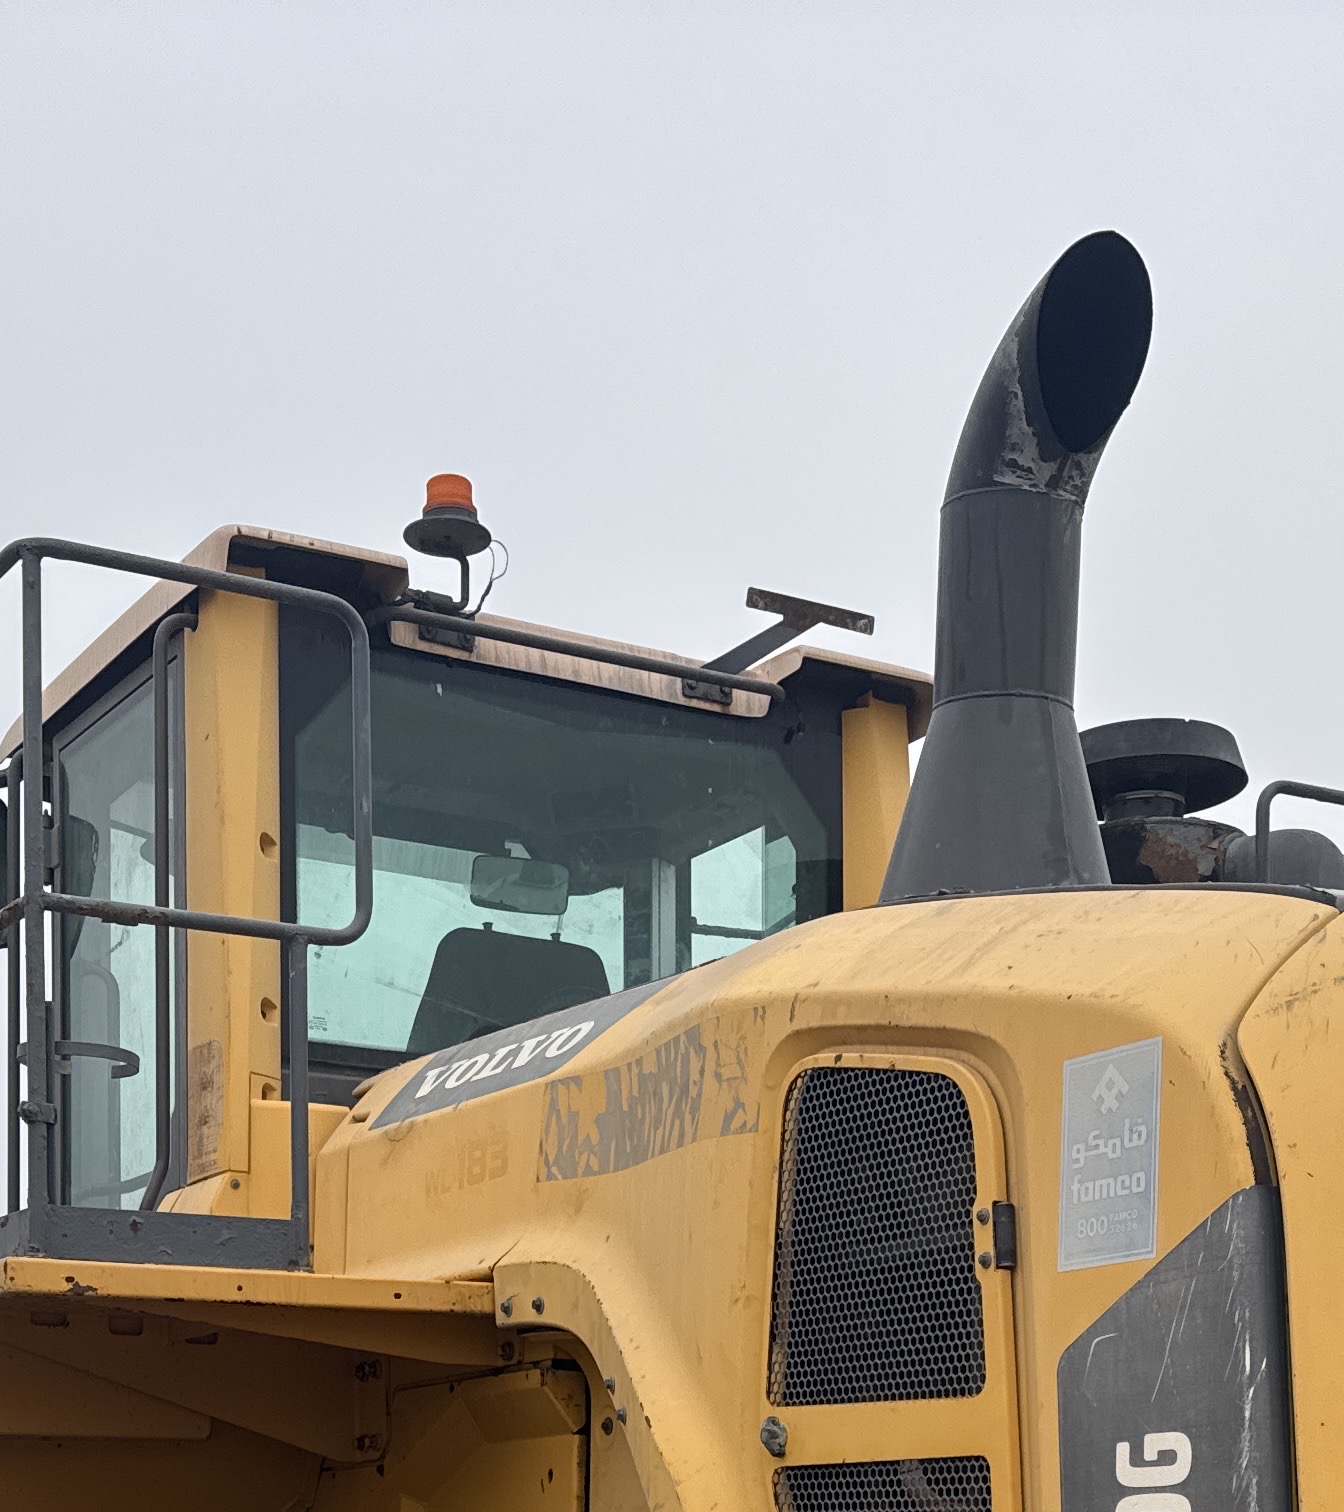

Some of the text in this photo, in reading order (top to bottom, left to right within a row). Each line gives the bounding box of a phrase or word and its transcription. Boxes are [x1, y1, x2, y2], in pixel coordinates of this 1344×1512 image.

[415, 1020, 595, 1099] VOLVO
[1072, 1118, 1147, 1169] فامكو
[1072, 1173, 1145, 1204] famco
[1077, 1216, 1107, 1239] 800
